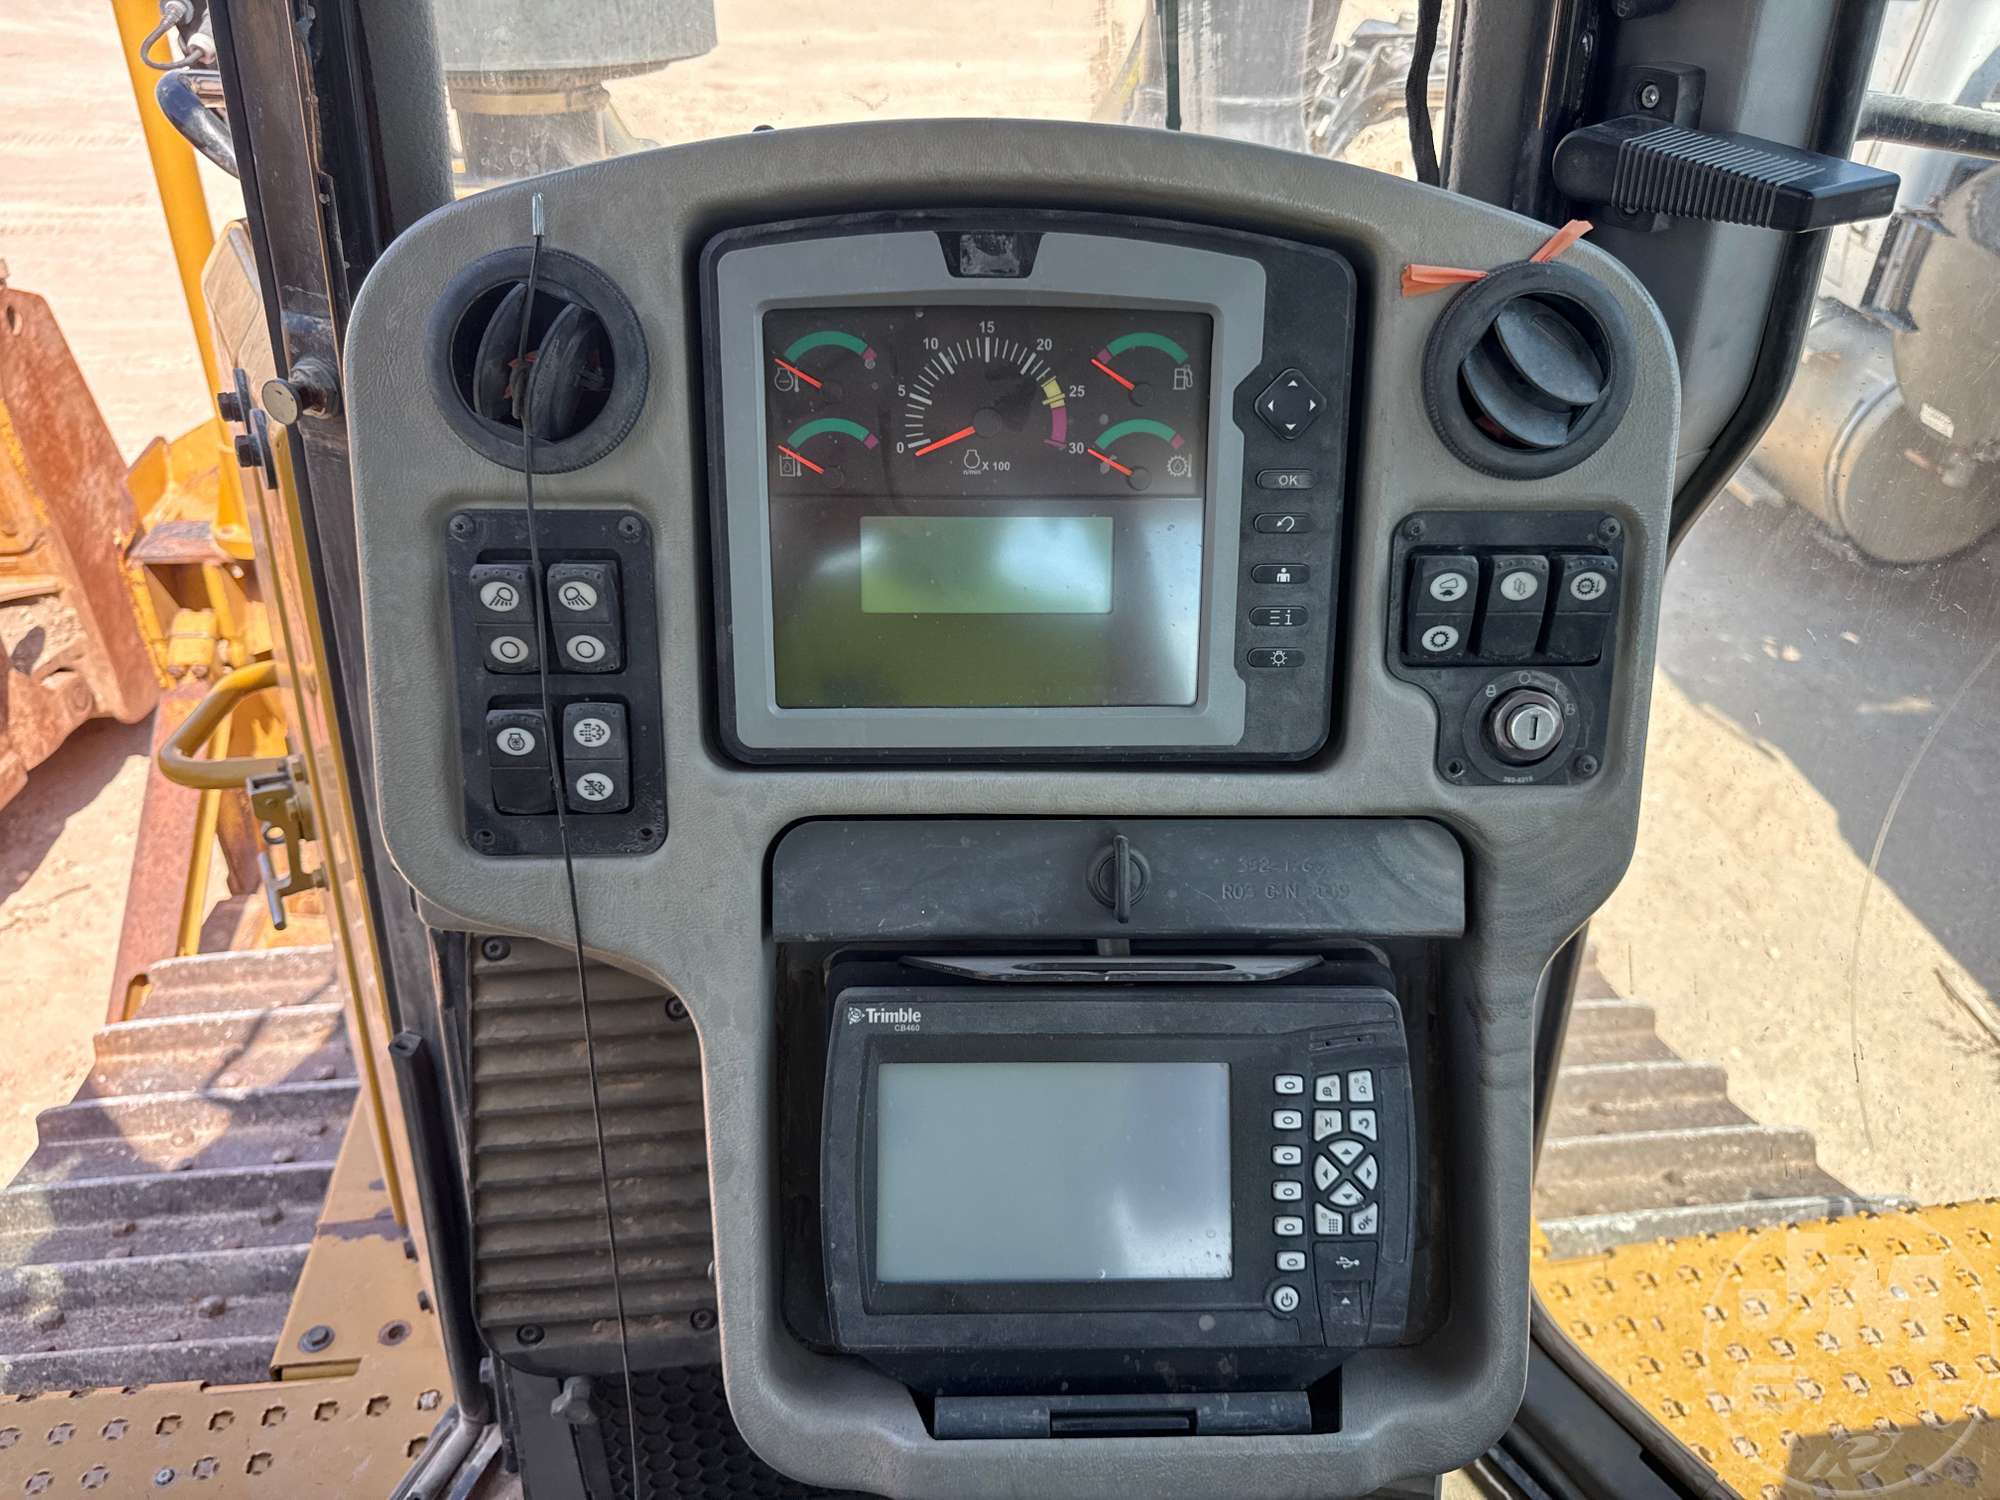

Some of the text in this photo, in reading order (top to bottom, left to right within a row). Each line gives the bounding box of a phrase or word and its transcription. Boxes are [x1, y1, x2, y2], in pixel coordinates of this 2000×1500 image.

[979, 321, 995, 334] 15
[923, 338, 939, 350] 10
[1036, 338, 1053, 350] 20
[897, 385, 906, 397] 5
[1069, 385, 1085, 398] 25
[896, 442, 904, 454] 0
[1068, 442, 1085, 454] 30
[993, 461, 1011, 471] 100
[1278, 474, 1298, 486] OK
[865, 1007, 922, 1023] Trimble
[894, 1024, 920, 1032] CB460
[1358, 1215, 1373, 1231] OK
